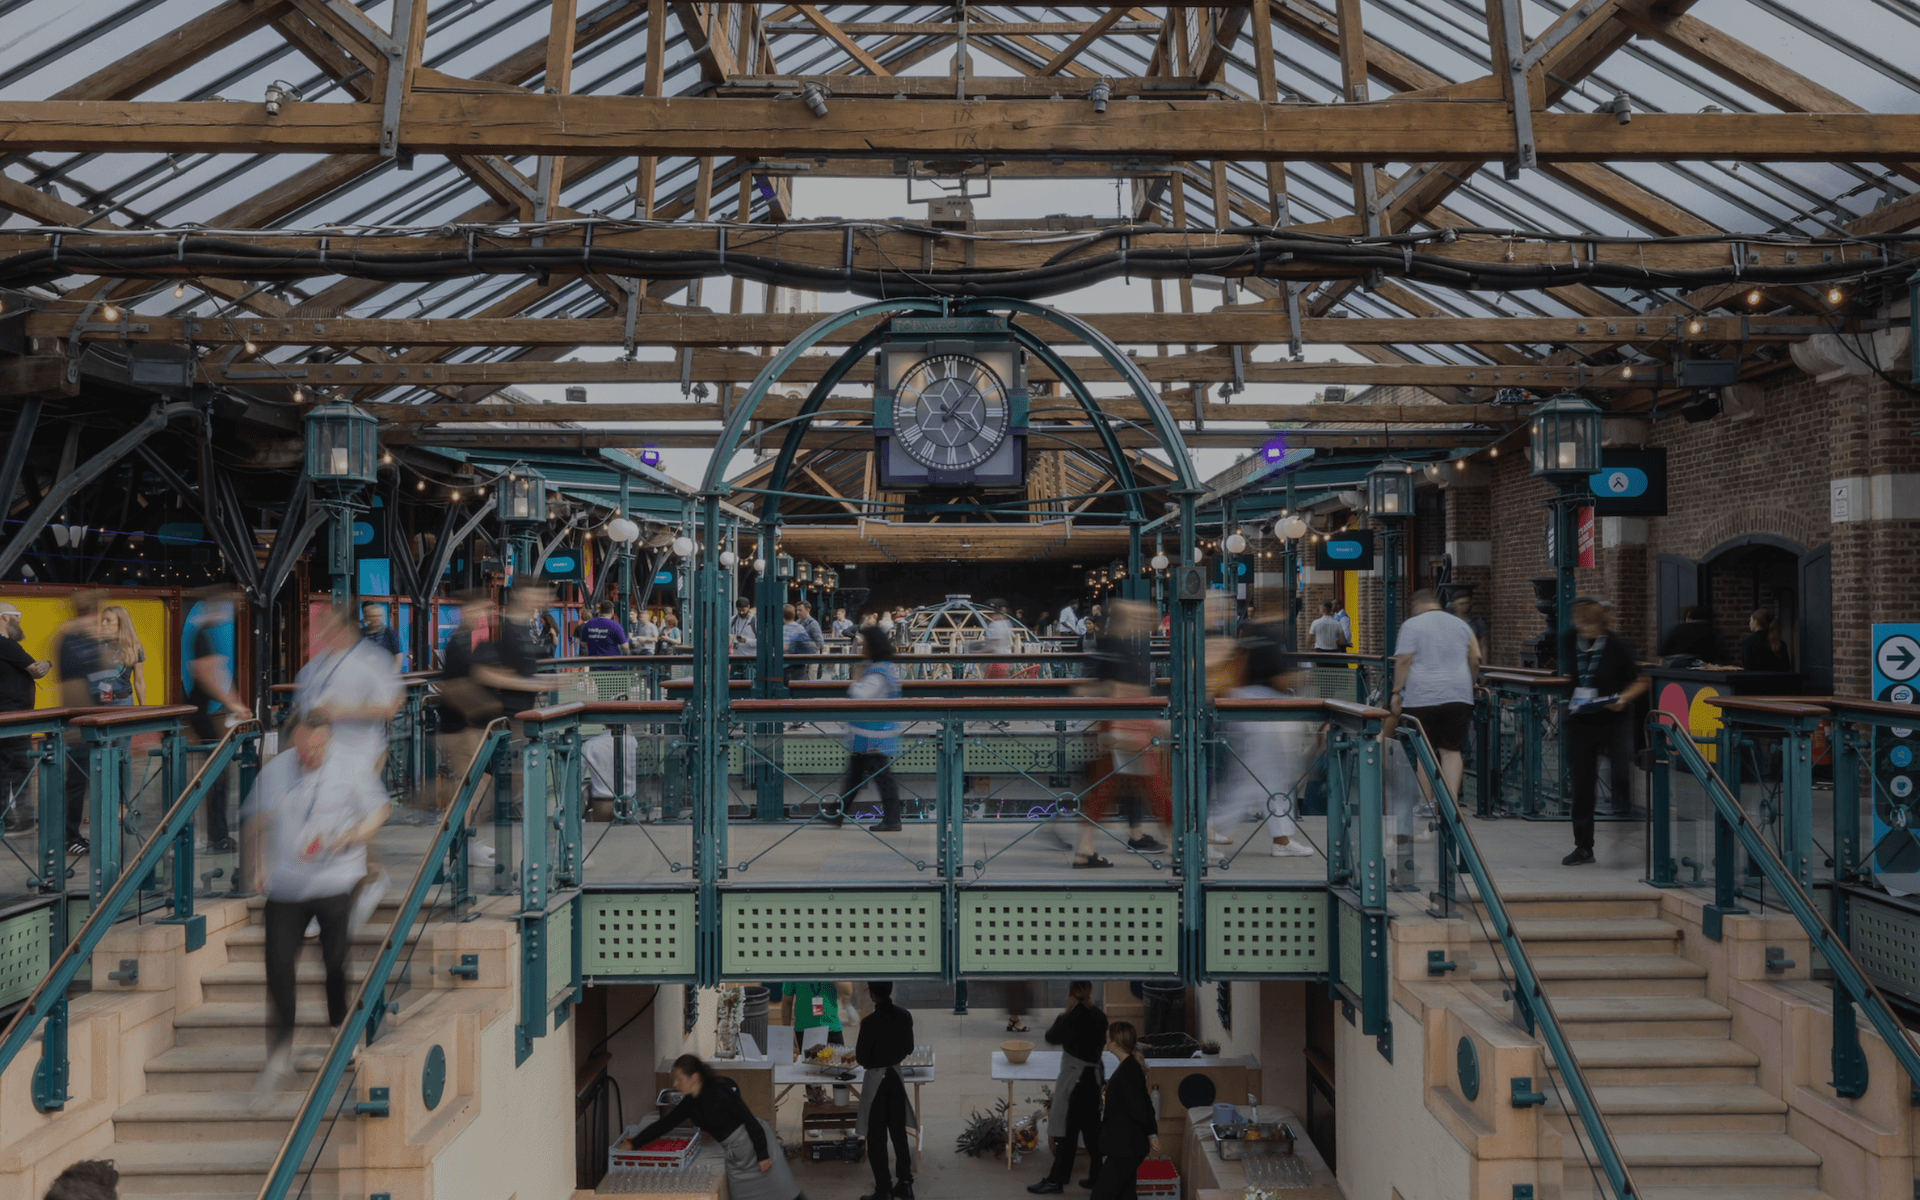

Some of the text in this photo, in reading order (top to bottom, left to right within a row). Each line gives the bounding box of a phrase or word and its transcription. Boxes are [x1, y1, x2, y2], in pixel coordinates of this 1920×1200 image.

[922, 366, 937, 385] XI
[944, 360, 957, 378] XII
[968, 367, 978, 383] I
[904, 384, 921, 397] X
[981, 384, 998, 397] II
[898, 406, 916, 416] IX
[986, 408, 1003, 417] III
[903, 424, 923, 445] VIII
[979, 425, 999, 443] IIII
[920, 440, 936, 460] VII
[947, 447, 957, 464] VI
[968, 442, 980, 459] V
